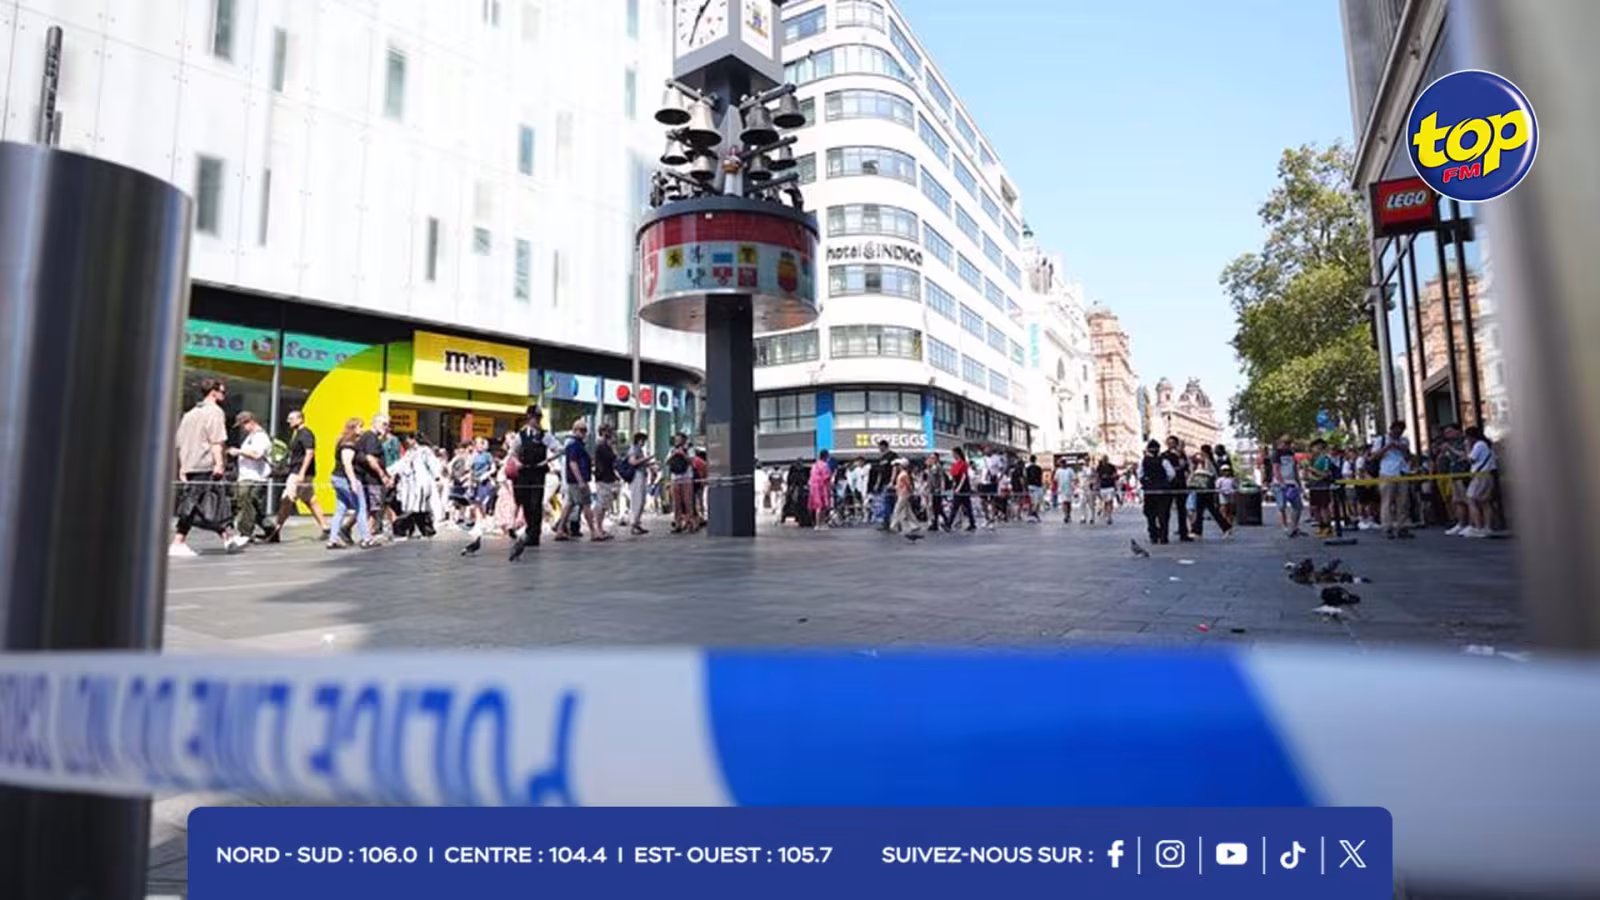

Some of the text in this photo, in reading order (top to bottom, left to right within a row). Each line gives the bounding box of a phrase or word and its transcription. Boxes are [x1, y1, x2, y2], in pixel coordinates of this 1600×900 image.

[1386, 191, 1427, 209] LEGO
[826, 242, 923, 266] hotel INDIGO
[871, 433, 928, 447] GREGGS
[306, 684, 578, 807] POLICE
